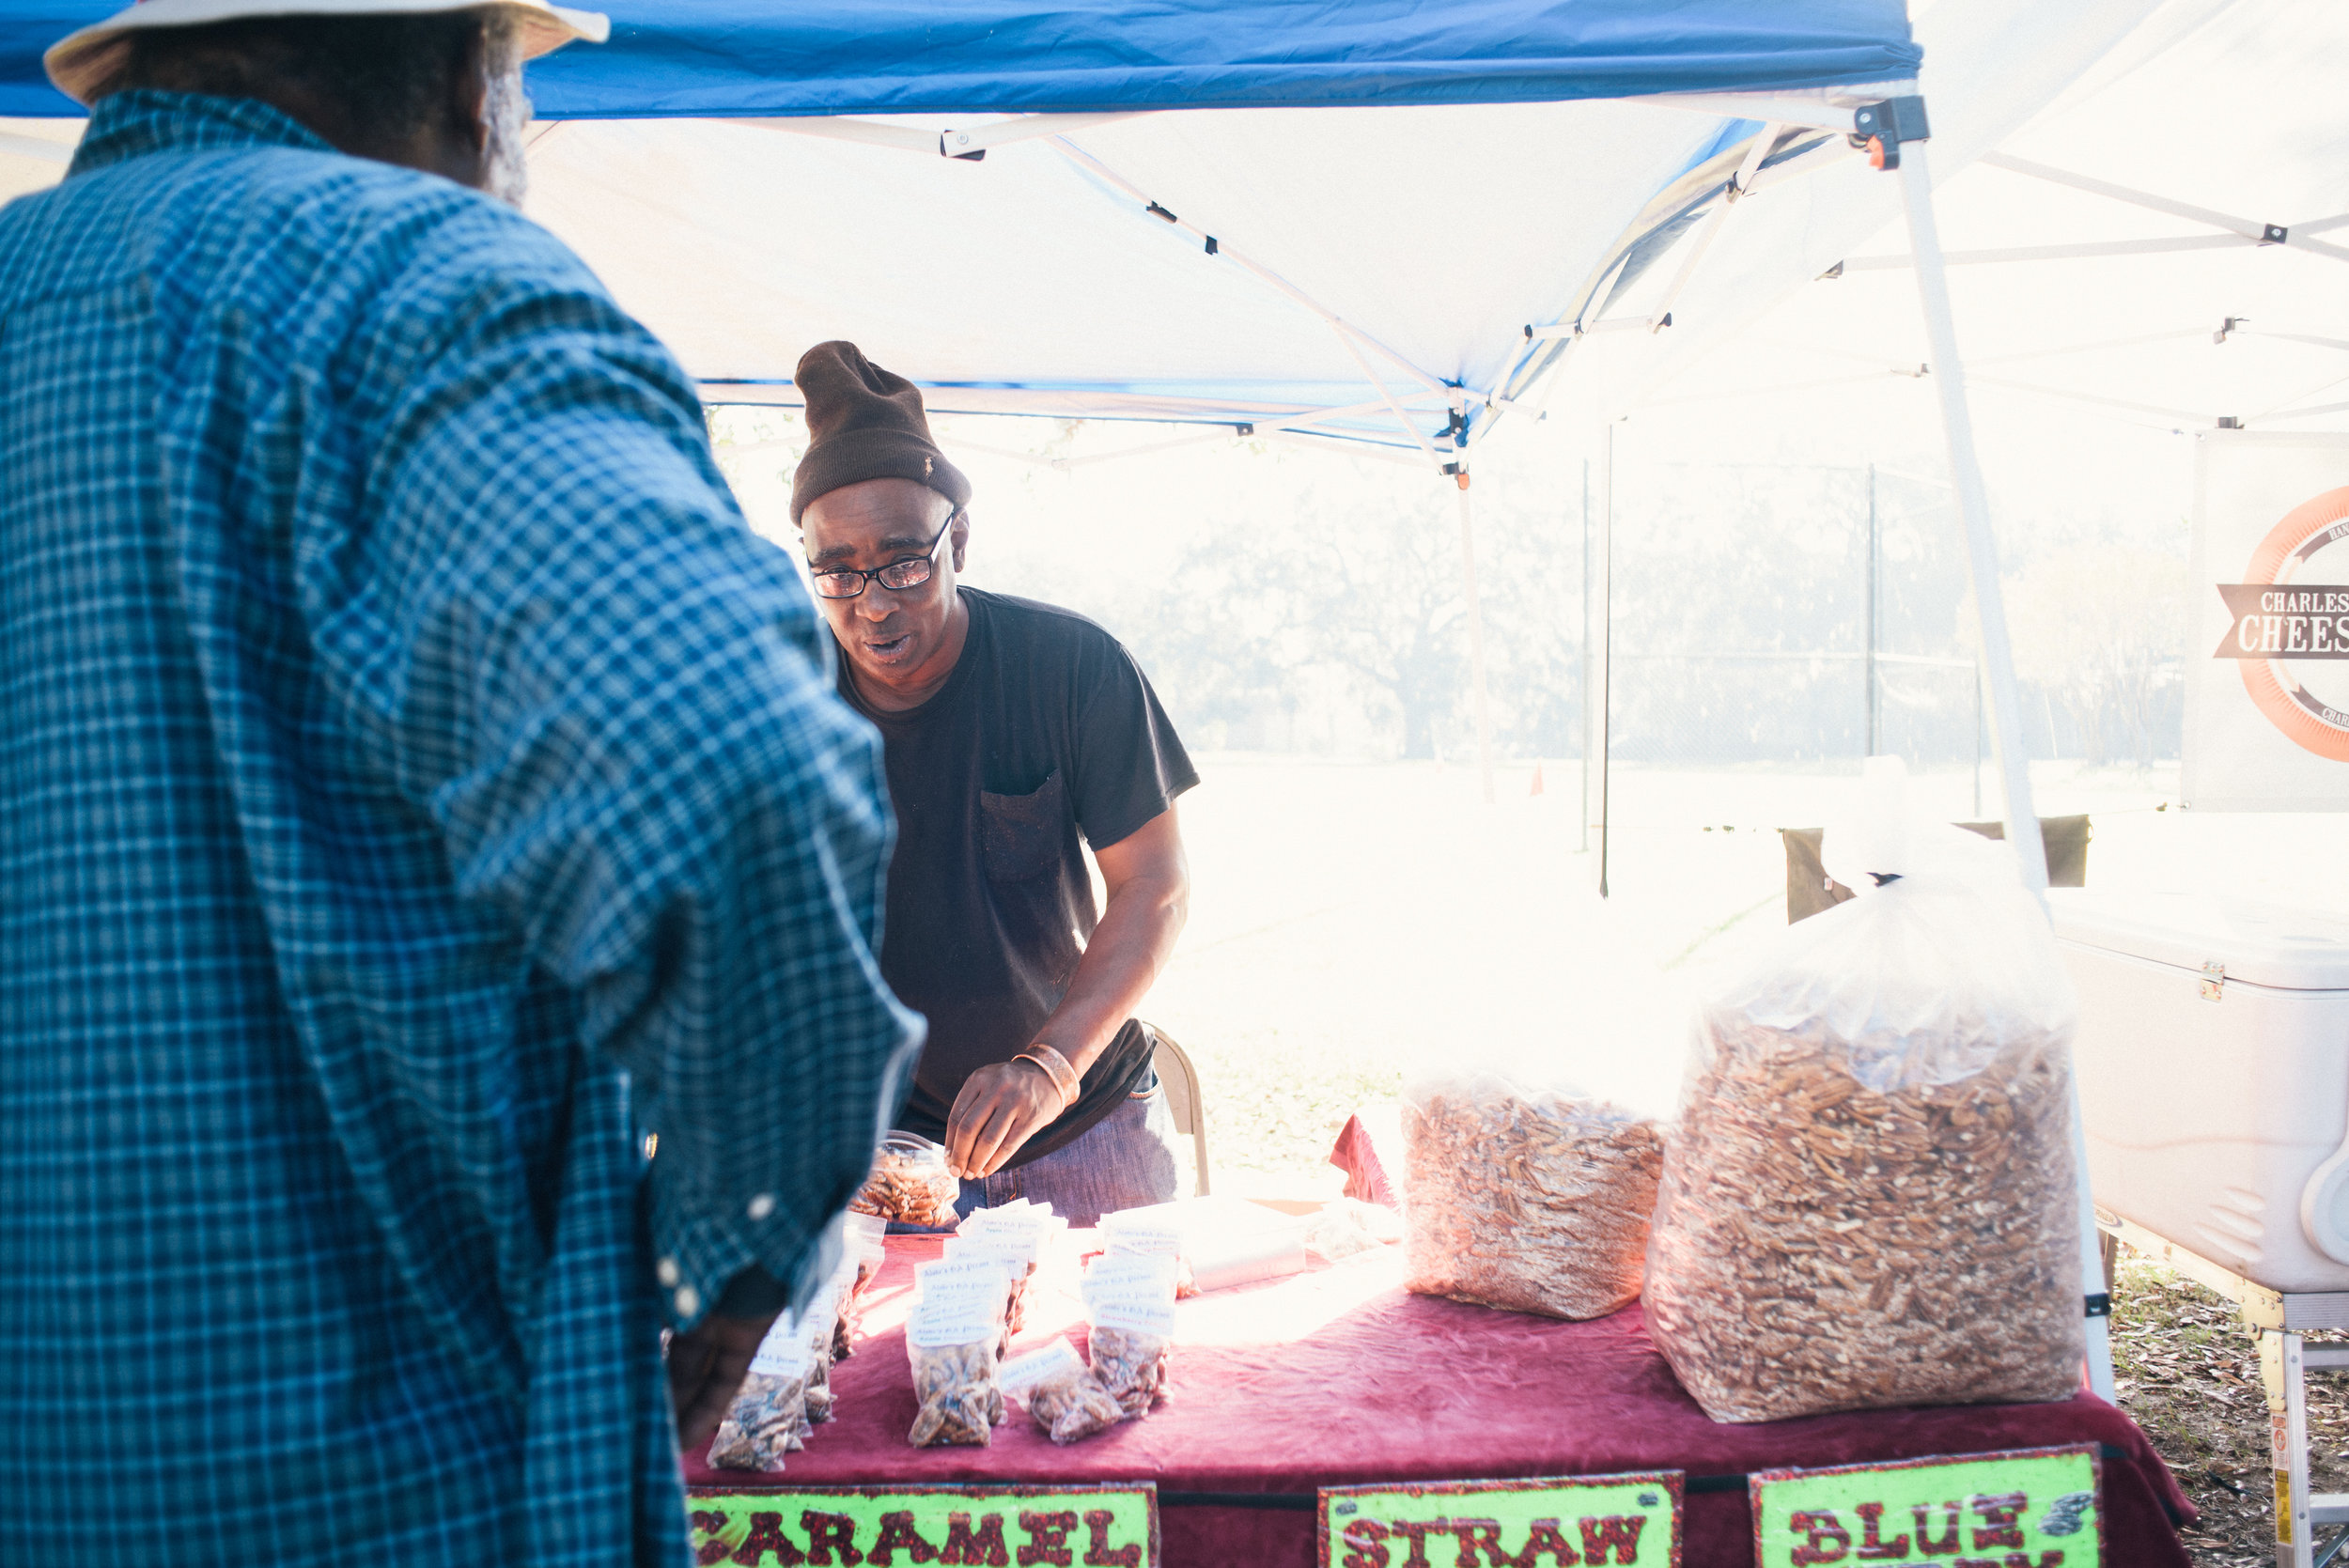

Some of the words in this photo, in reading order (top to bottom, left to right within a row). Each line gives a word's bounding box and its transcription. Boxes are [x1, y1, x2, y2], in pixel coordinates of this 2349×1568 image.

[2260, 591, 2349, 613] CHARLES
[2238, 613, 2349, 652] CHEES
[1342, 1515, 1647, 1568] STRAW
[1790, 1490, 2028, 1568] BLUE
